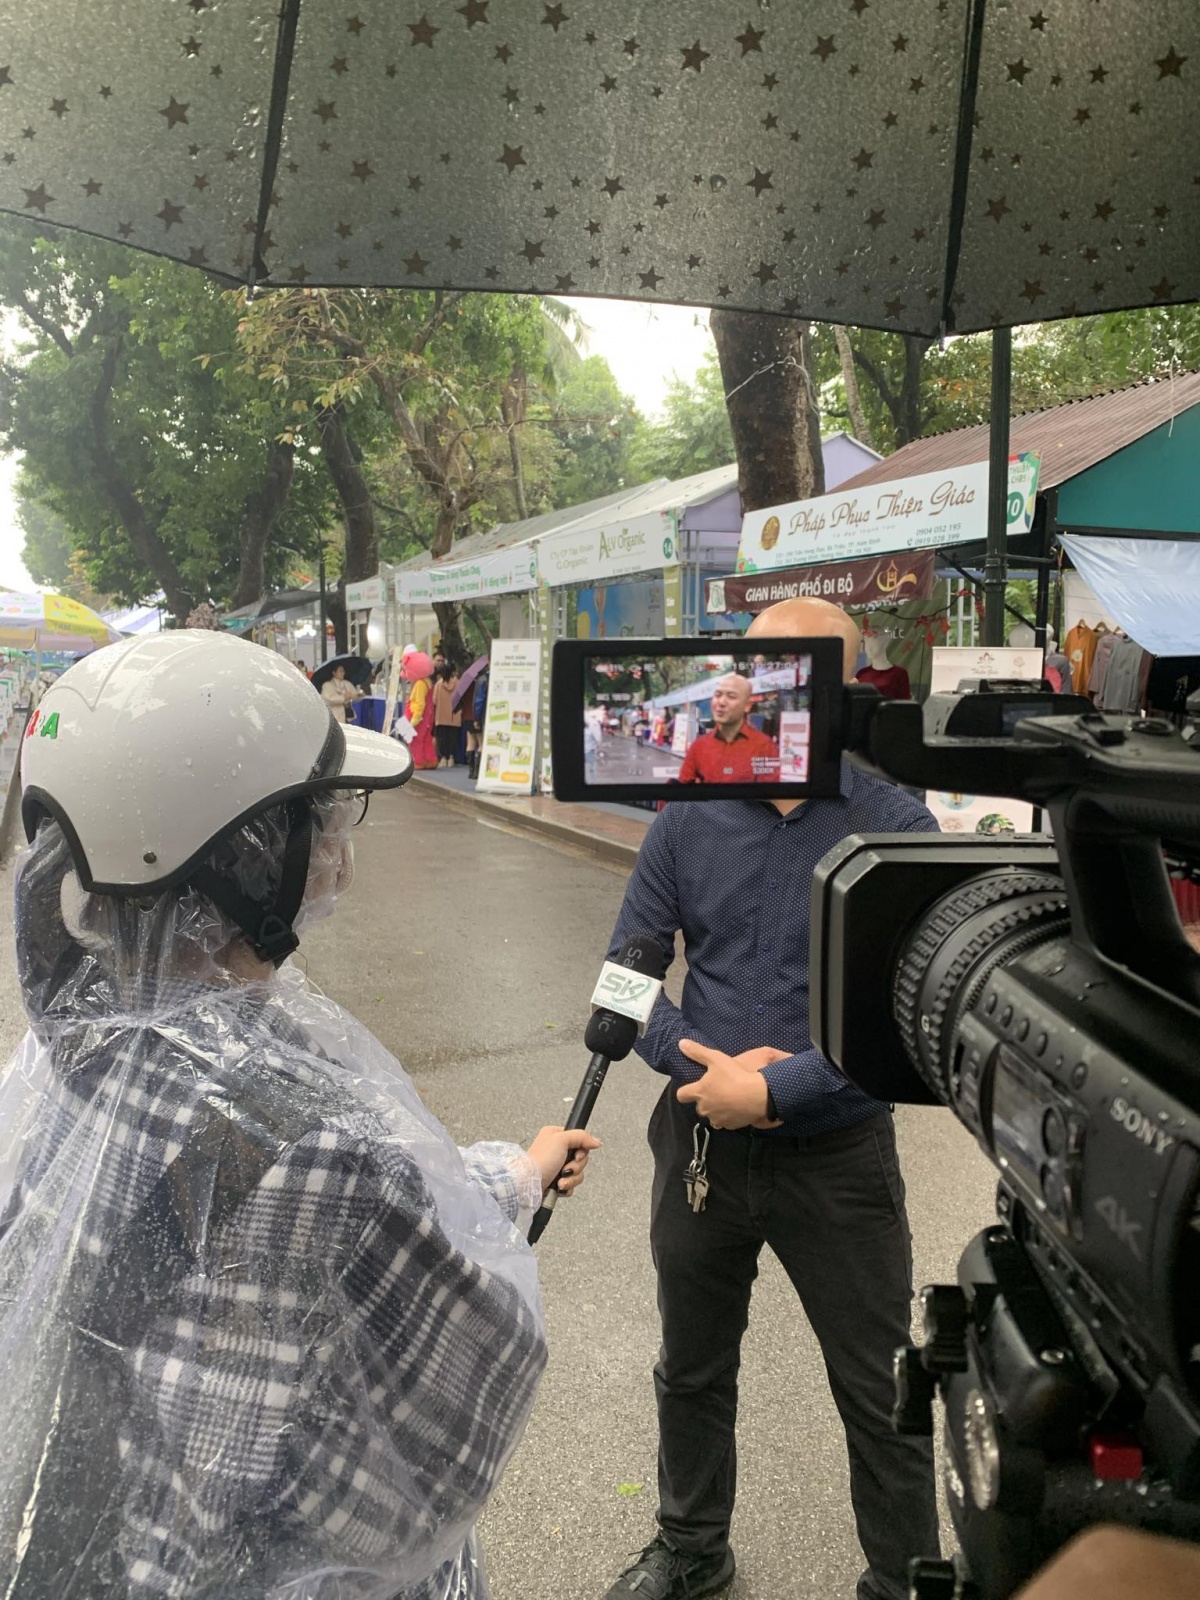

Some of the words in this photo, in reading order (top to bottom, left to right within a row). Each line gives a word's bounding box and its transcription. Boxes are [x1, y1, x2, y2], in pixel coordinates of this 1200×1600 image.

[788, 508, 825, 540] Pháp
[830, 500, 870, 528] Phục
[876, 490, 922, 520] Thiện
[928, 481, 975, 517] Giác
[745, 585, 769, 603] GIAN
[770, 580, 798, 601] HÀNG
[799, 573, 822, 598] PHỐ
[823, 579, 835, 596] ĐI
[838, 572, 854, 596] BỘ
[1110, 1097, 1174, 1155] SONY
